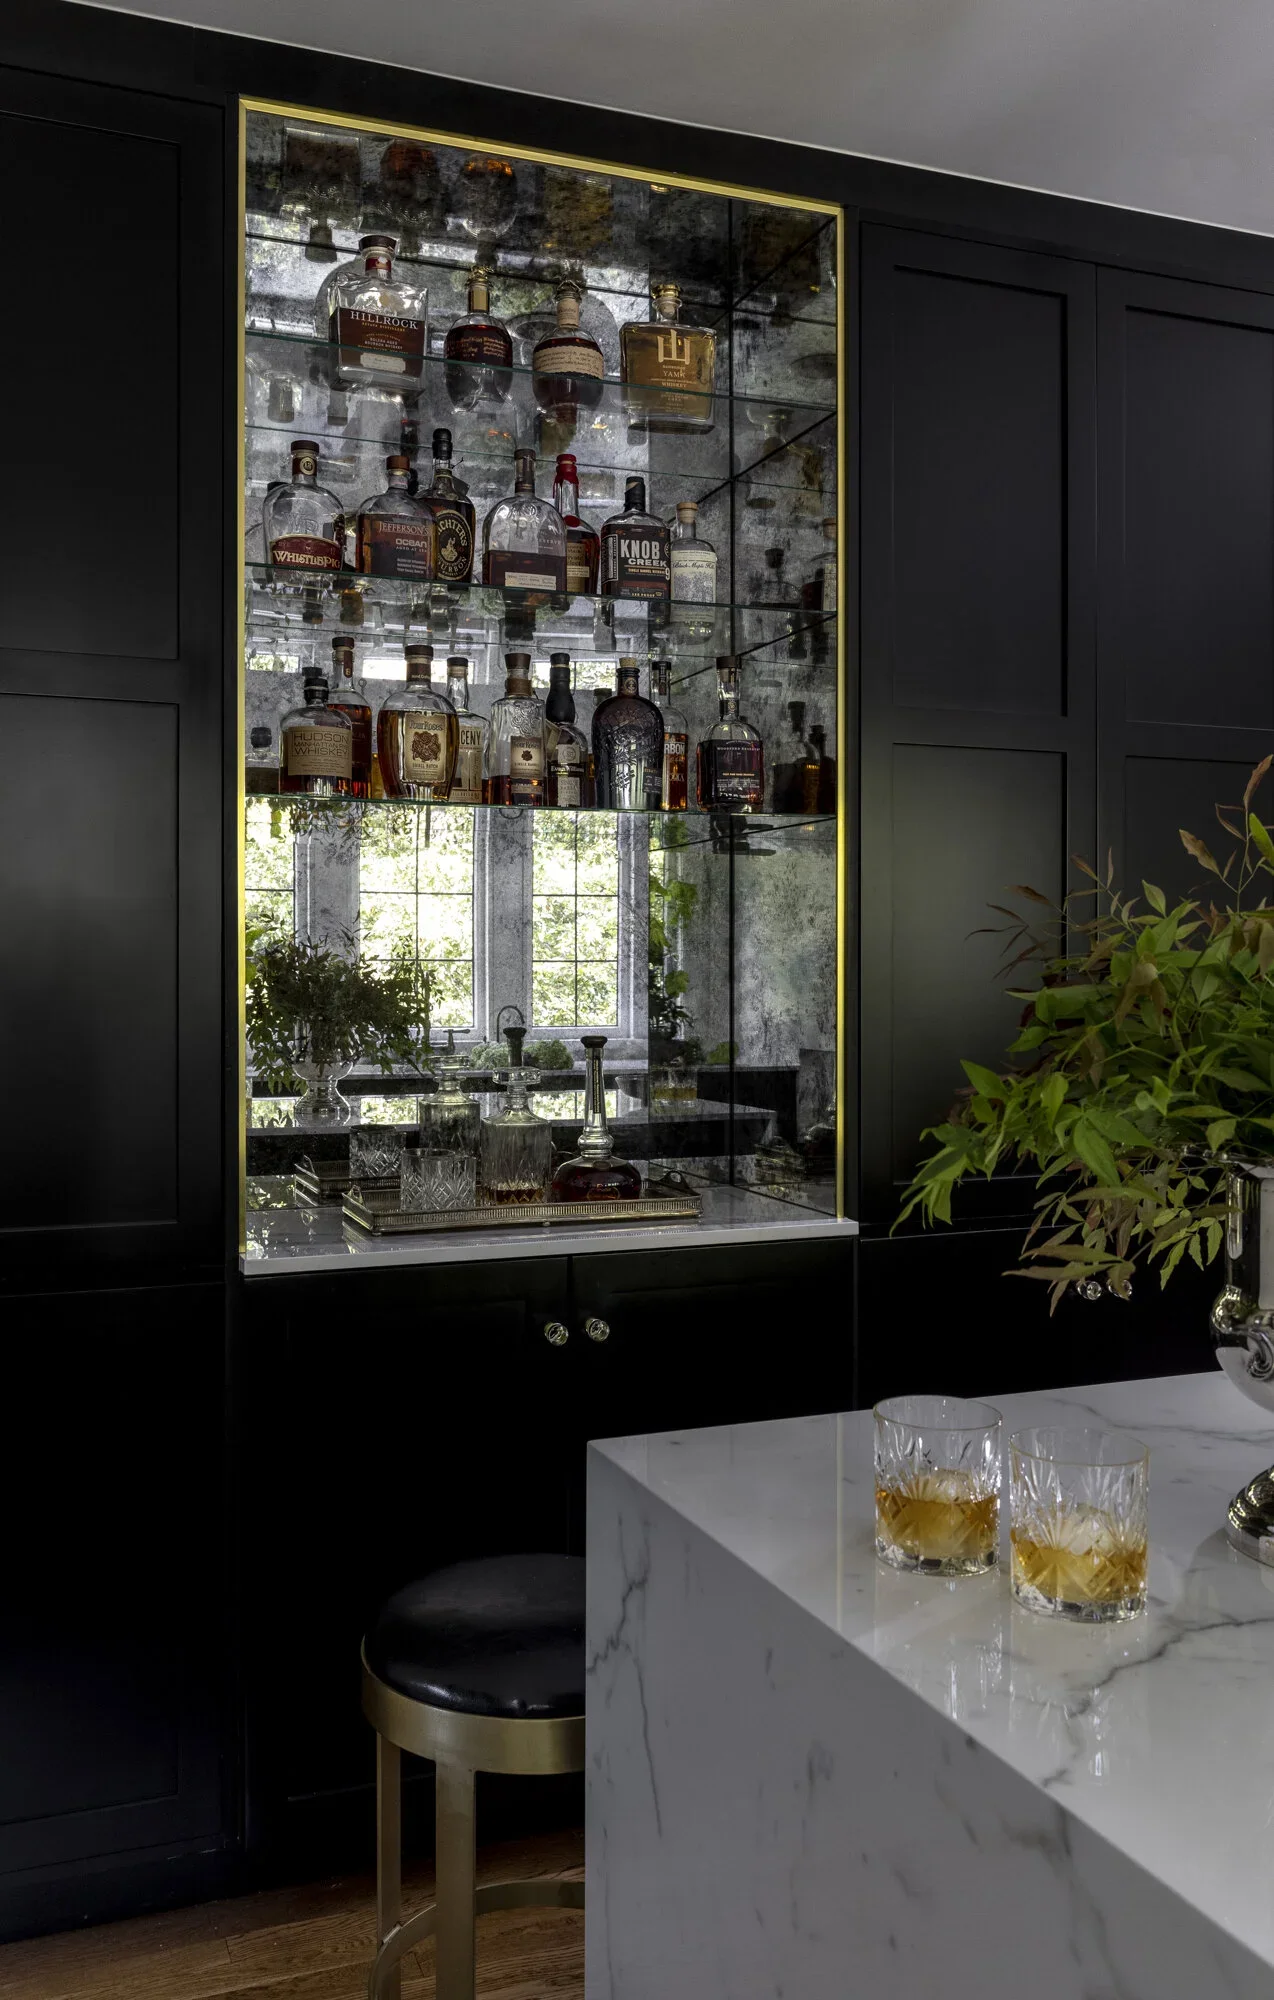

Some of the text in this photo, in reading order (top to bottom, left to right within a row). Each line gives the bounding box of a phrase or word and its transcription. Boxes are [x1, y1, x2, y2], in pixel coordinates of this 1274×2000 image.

[350, 311, 418, 330] HILLROCK
[379, 521, 430, 537] JEFFERSON'S
[436, 520, 468, 547] ICHTER'S
[396, 538, 428, 548] OCEAN
[620, 539, 660, 560] KNOB
[628, 559, 667, 567] CREEK
[665, 567, 671, 580] 9
[294, 732, 349, 744] HUDSON
[460, 730, 481, 745] CENY
[295, 747, 348, 757] WHISKEY
